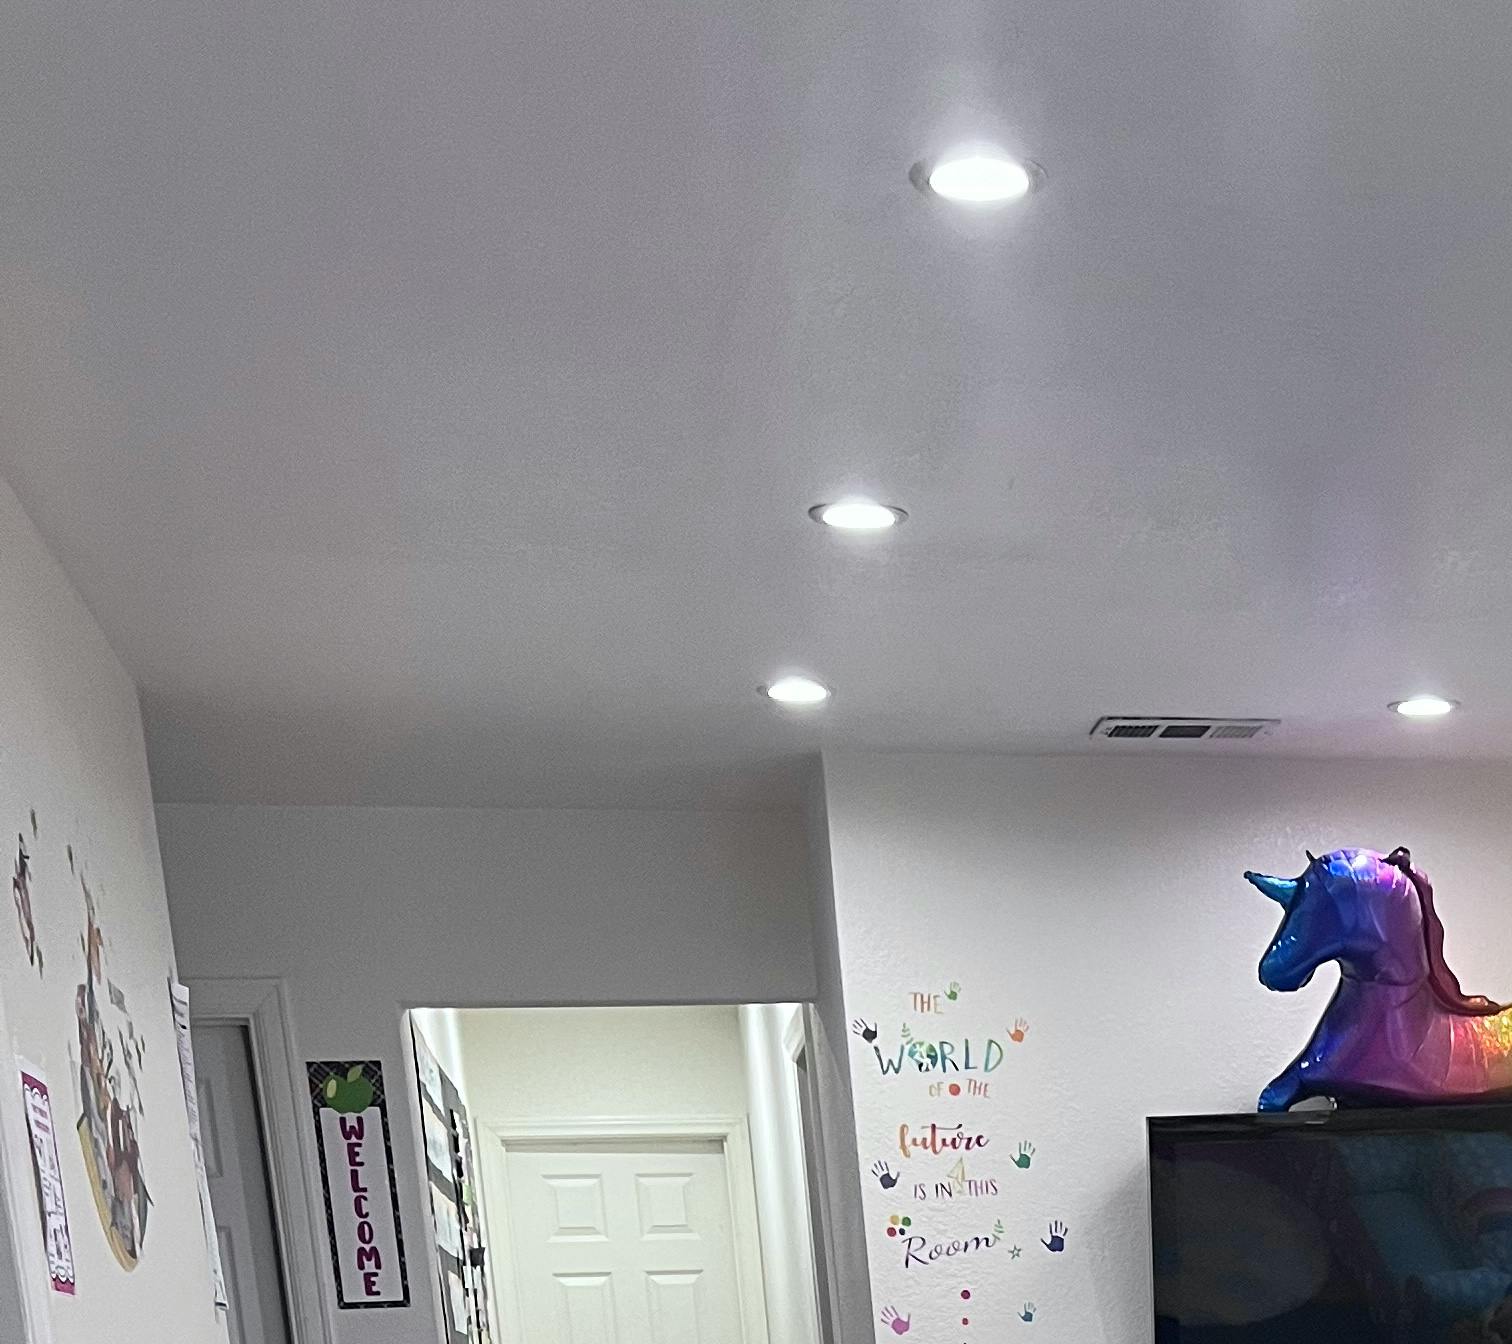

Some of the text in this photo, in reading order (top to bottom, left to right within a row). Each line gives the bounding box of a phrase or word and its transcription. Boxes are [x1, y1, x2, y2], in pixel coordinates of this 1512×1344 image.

[909, 992, 944, 1014] THE
[929, 1078, 991, 1098] OF THE
[898, 1123, 990, 1158] future
[913, 1179, 998, 1200] IS IN THIS
[339, 1116, 382, 1297] WELCOME
[902, 1235, 994, 1269] Room
